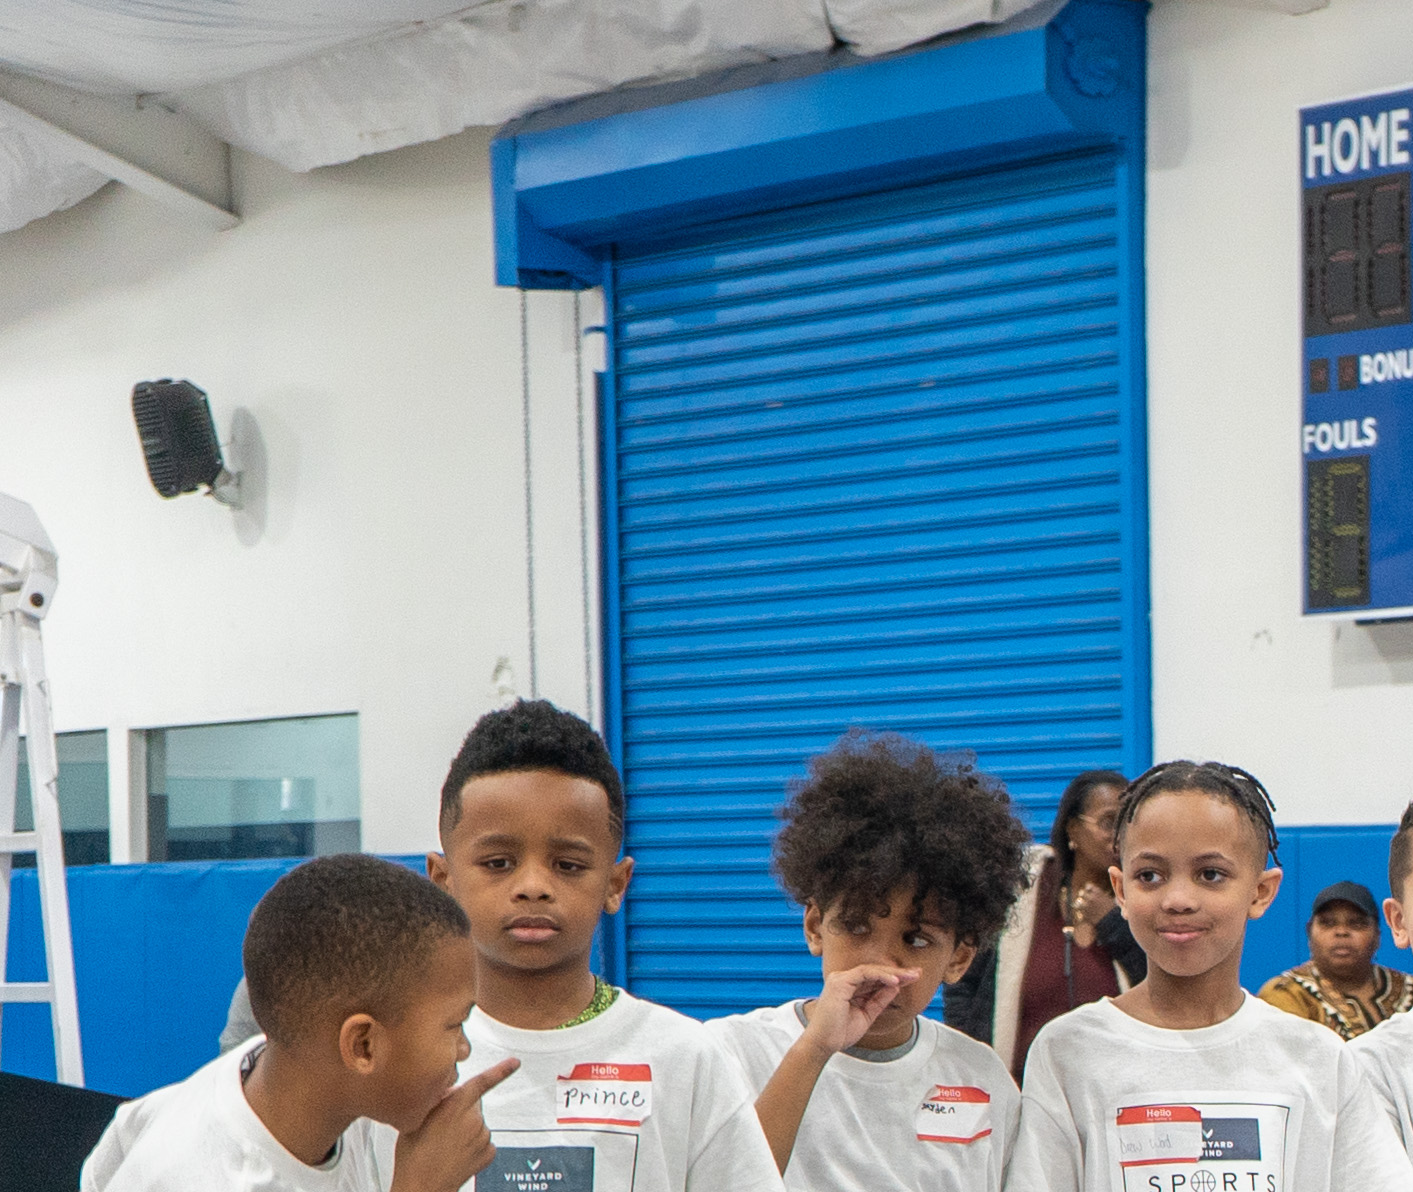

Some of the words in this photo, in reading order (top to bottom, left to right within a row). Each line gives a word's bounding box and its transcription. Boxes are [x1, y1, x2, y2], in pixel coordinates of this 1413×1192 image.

[1306, 109, 1410, 179] HOME
[1303, 418, 1377, 453] FOULS
[591, 1065, 620, 1075] Hello
[1146, 1109, 1172, 1118] Hello
[1201, 1141, 1234, 1149] EYARD
[504, 1172, 562, 1182] VINEYARD
[518, 1182, 548, 1191] WIND
